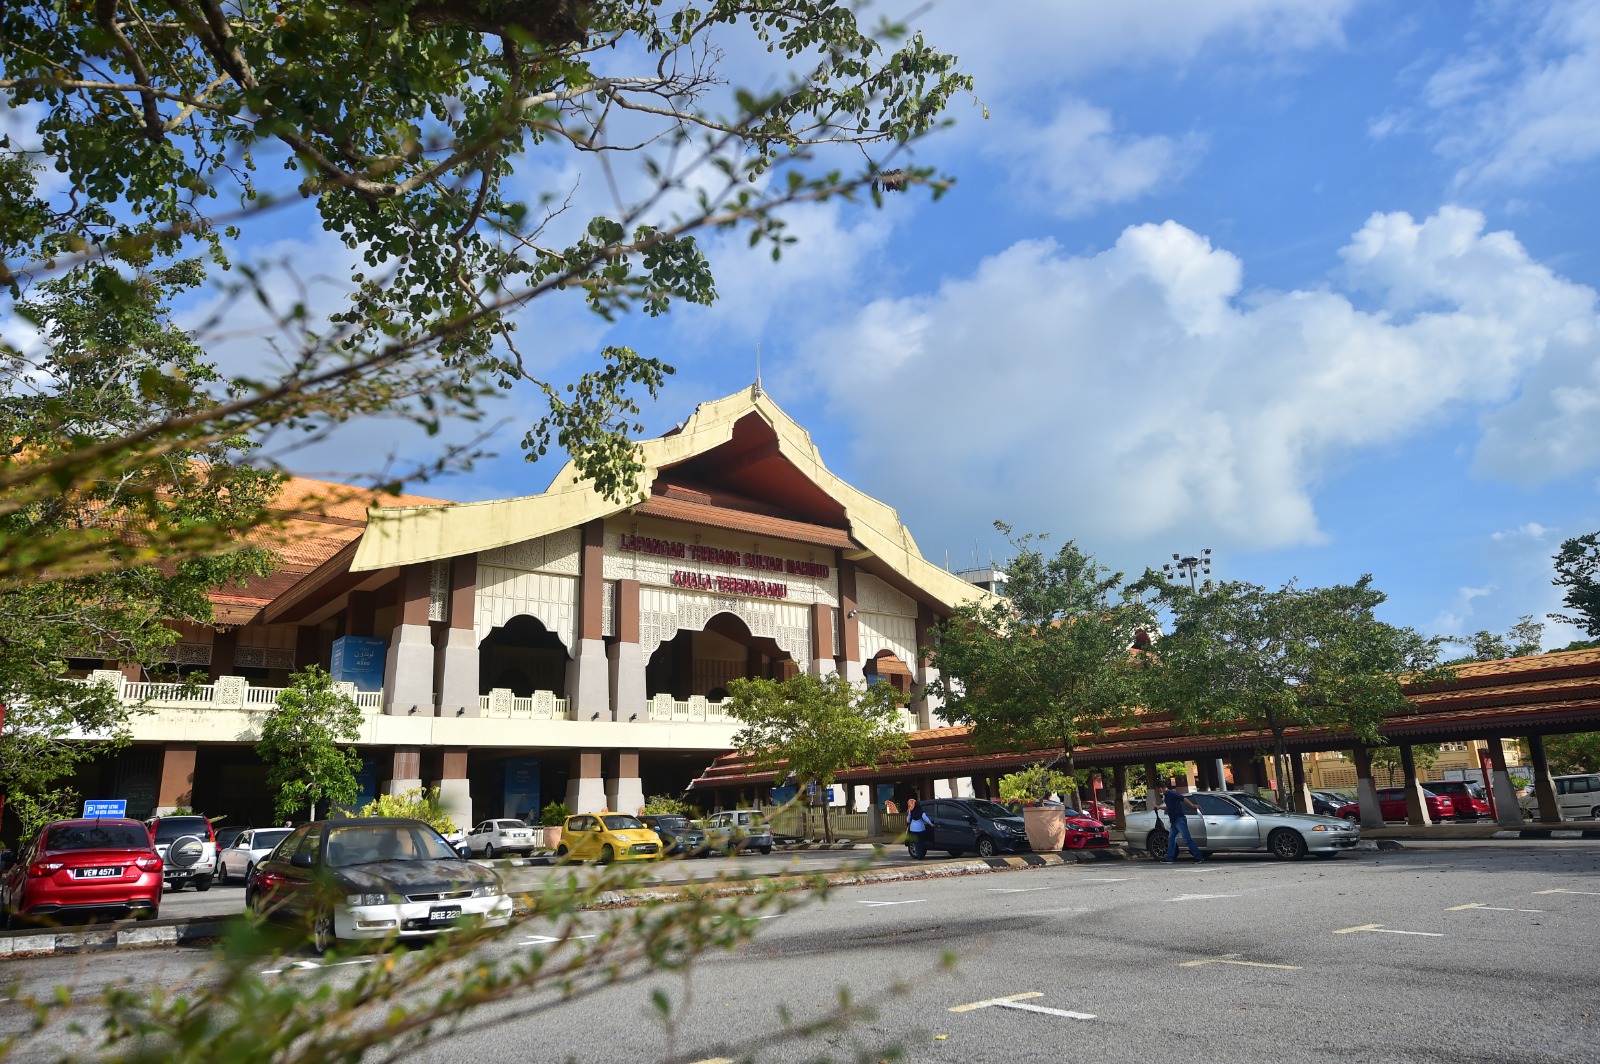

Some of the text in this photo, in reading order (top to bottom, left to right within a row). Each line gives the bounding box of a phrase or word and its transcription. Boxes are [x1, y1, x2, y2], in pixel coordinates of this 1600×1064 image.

[620, 533, 830, 579] LAPANGAN TERBANG SULTAN MAHMUD
[673, 570, 787, 598] KUALA TERENGGANU
[87, 806, 94, 814] P
[98, 868, 115, 876] 4571
[430, 911, 445, 920] BEE
